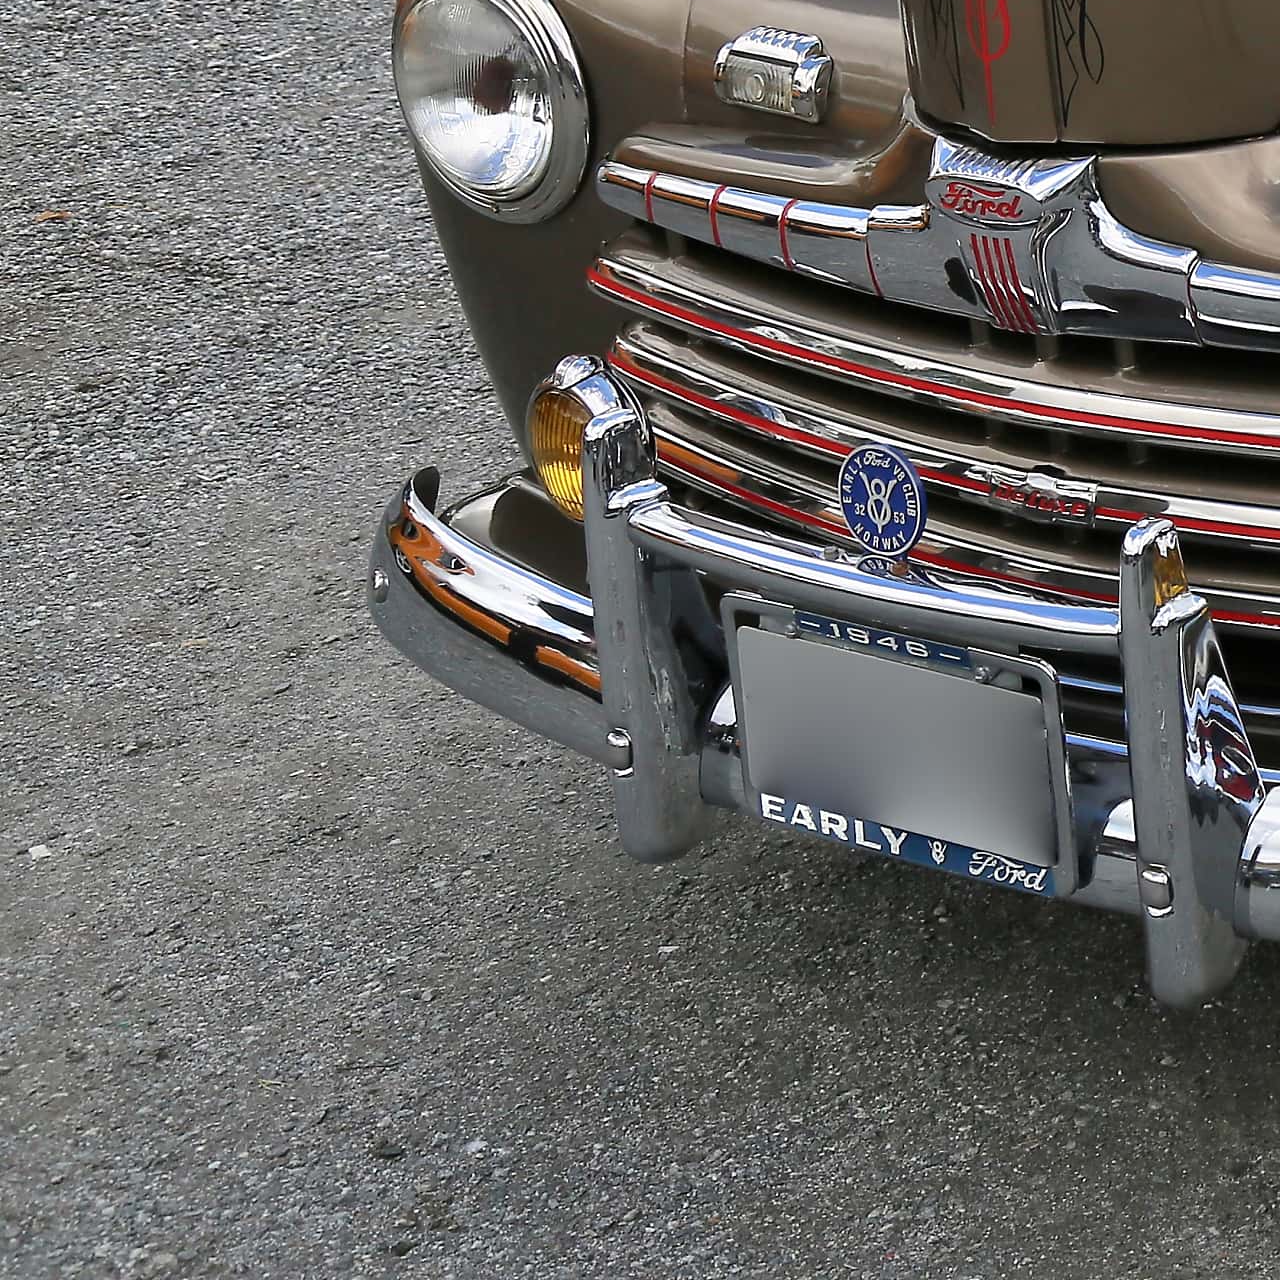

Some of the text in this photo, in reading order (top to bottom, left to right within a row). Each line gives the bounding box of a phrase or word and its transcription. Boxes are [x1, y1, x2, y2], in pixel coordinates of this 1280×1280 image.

[941, 181, 1024, 219] Ford
[842, 451, 917, 517] EARLY Ford V8 CLUB
[854, 503, 906, 525] 32 53
[853, 522, 907, 550] NORWAY
[759, 792, 909, 855] EARLY
[967, 850, 1047, 893] Ford
